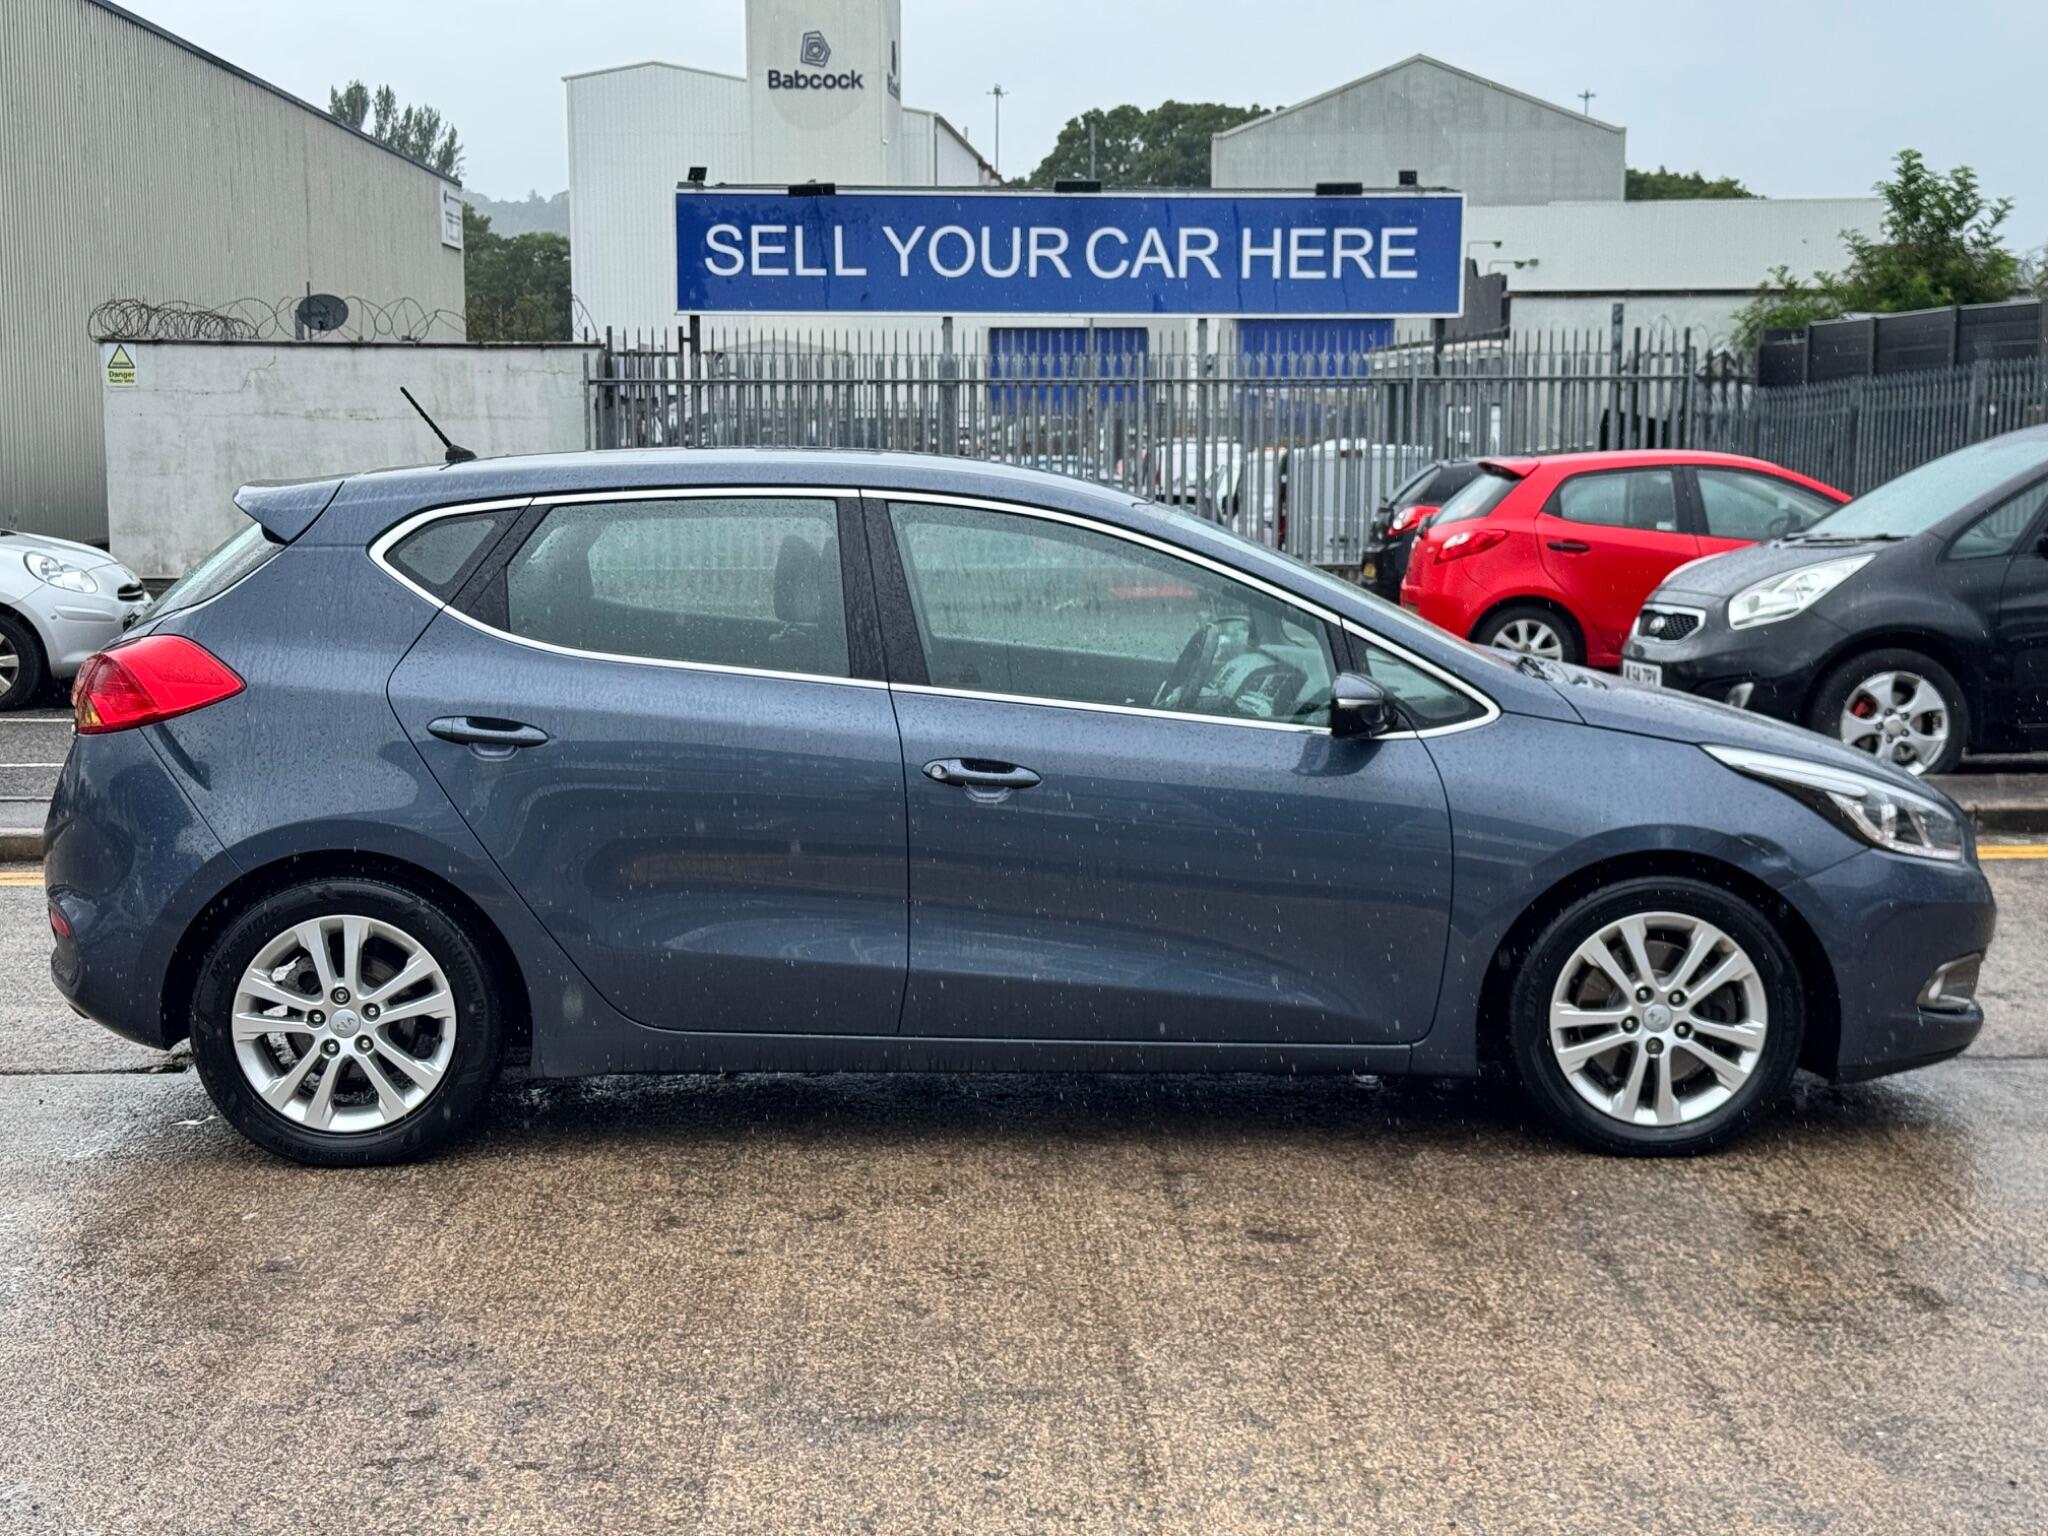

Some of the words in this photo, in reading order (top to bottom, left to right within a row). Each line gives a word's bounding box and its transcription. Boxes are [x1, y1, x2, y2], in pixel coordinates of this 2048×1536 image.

[767, 69, 864, 90] Babcock
[704, 223, 867, 278] SELL
[883, 224, 1072, 279] YOUR
[1085, 225, 1222, 281] CAR
[1241, 227, 1419, 280] HERE
[108, 371, 135, 379] Danger
